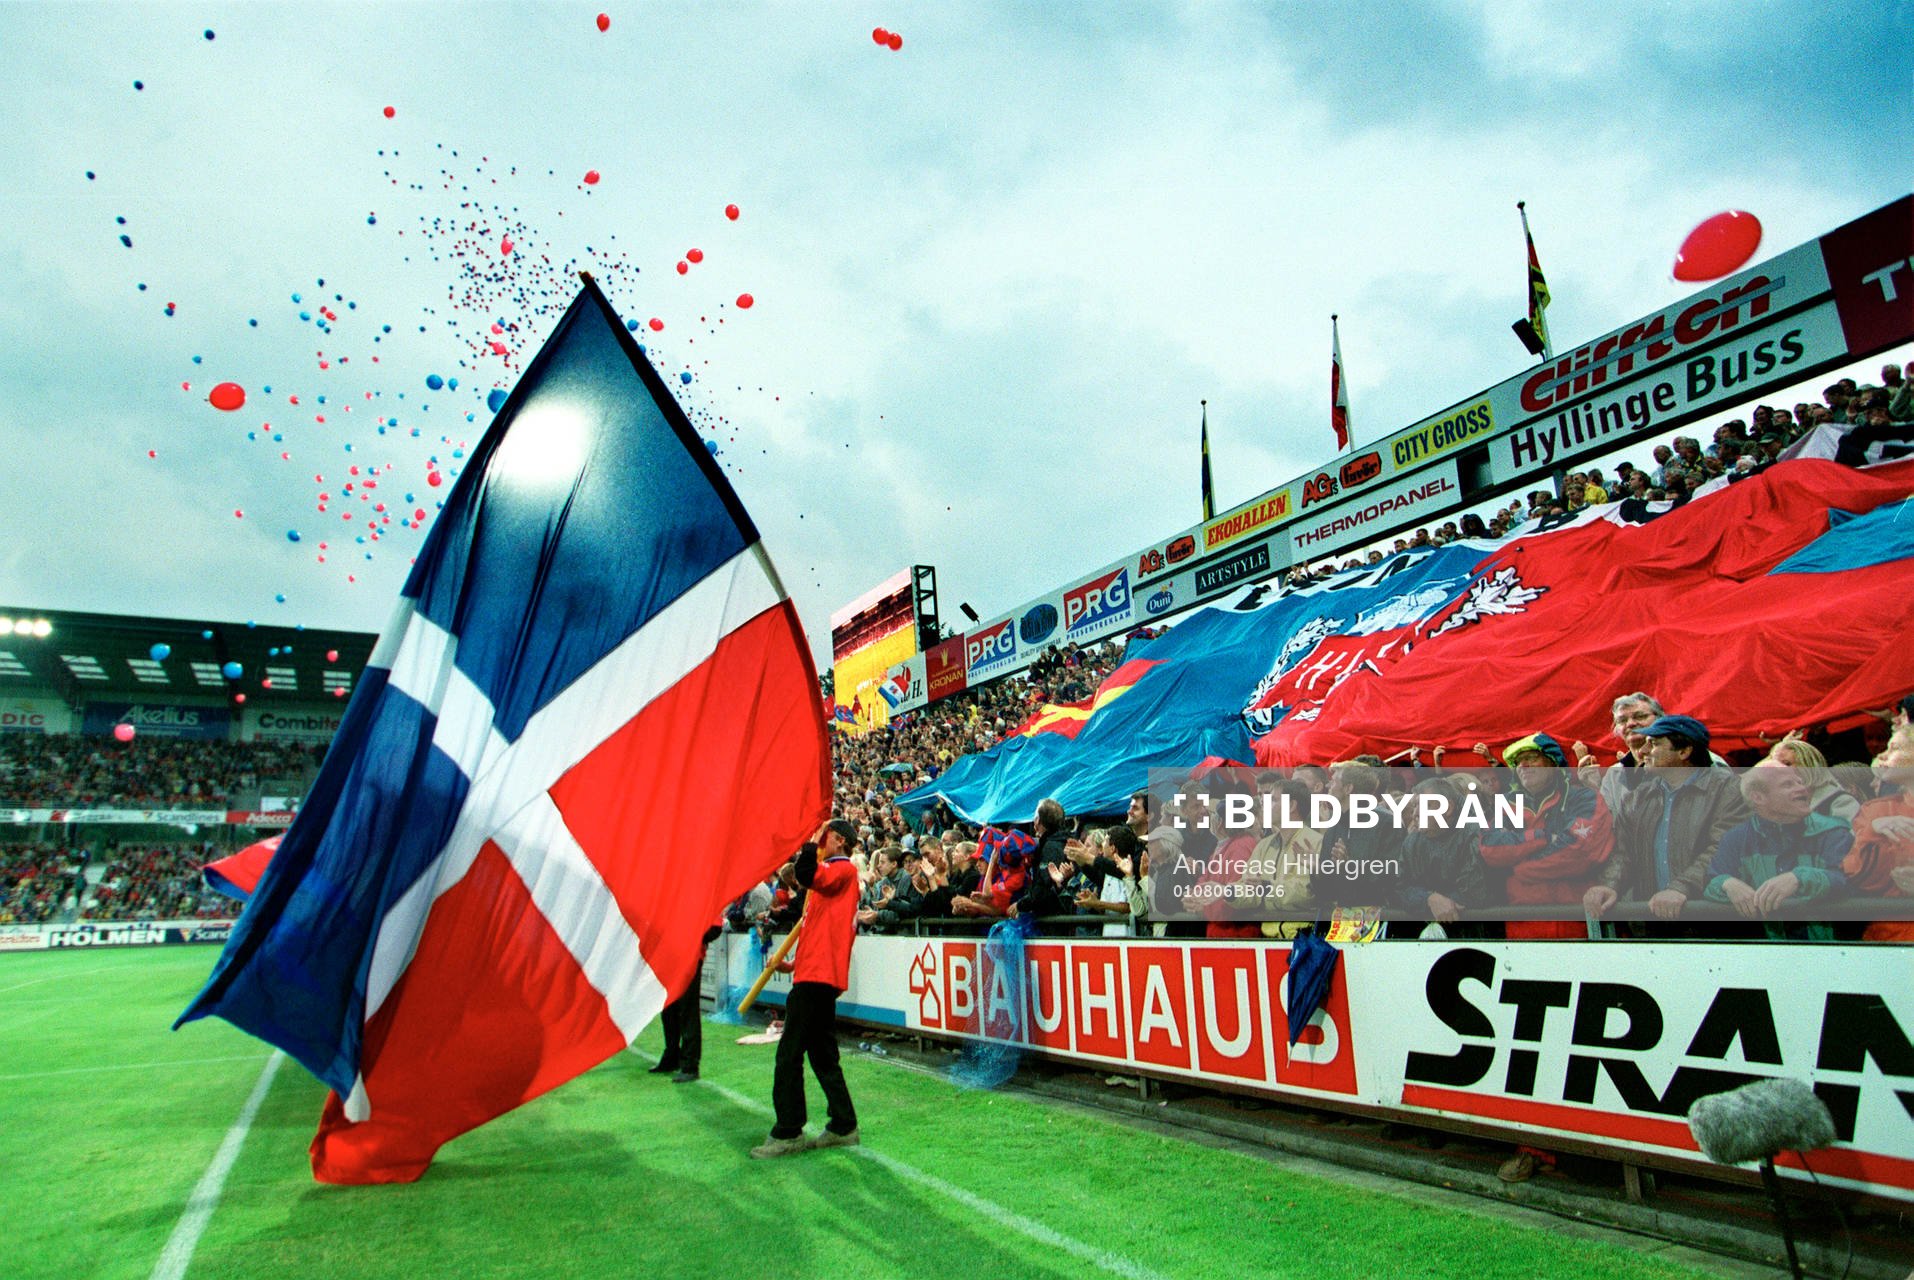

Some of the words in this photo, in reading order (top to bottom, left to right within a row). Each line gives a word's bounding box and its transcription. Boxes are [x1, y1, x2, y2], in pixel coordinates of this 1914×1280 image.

[1862, 256, 1914, 302] T
[1510, 382, 1676, 468] Hyllinge
[1687, 329, 1804, 403] Buss
[1395, 430, 1429, 466] CITY
[1433, 405, 1491, 449] GROSS
[1207, 495, 1287, 546] EKOHALLEN
[1294, 478, 1455, 548] THERMOPANEL
[1200, 551, 1267, 587] ARTSTYLE
[1067, 579, 1126, 627] PRG
[1150, 592, 1172, 611] Duni
[1066, 610, 1131, 640] PRESENTREKLAM
[969, 629, 1013, 667] PRG
[929, 669, 964, 691] KRONAN
[119, 705, 199, 726] Akelius
[51, 929, 167, 947] HOLMEN
